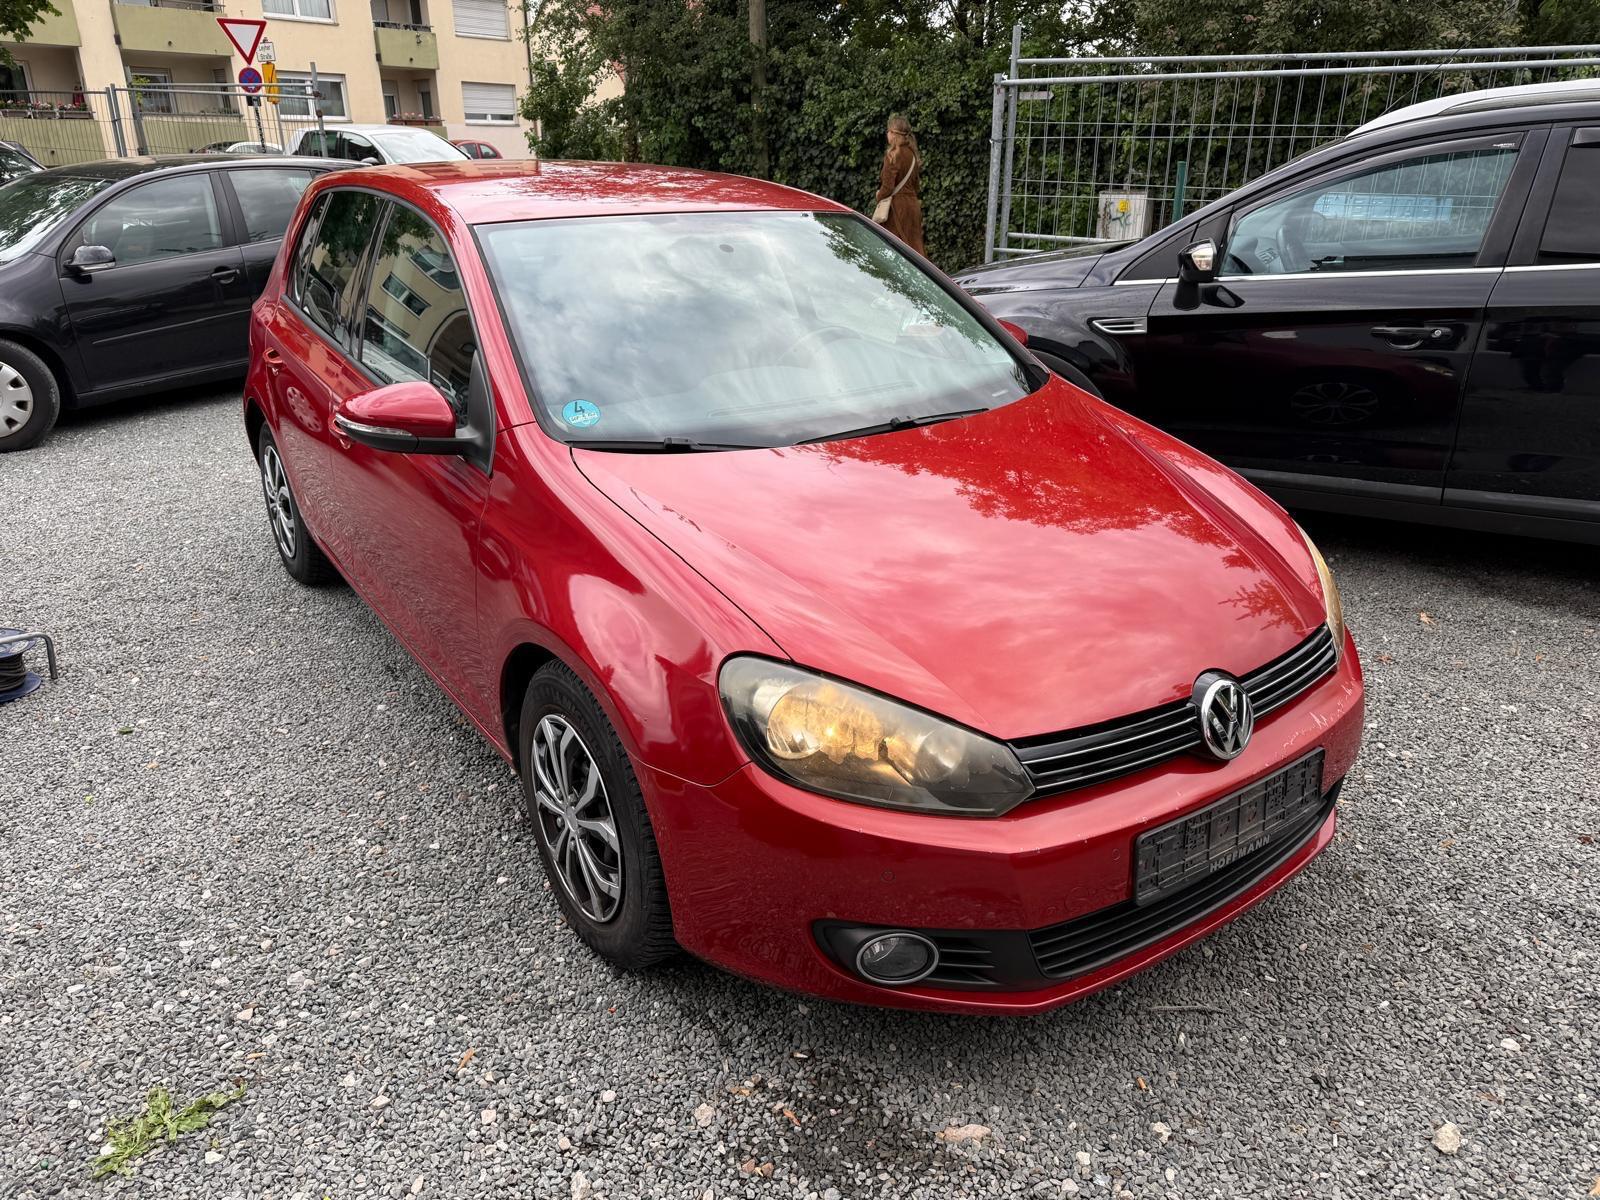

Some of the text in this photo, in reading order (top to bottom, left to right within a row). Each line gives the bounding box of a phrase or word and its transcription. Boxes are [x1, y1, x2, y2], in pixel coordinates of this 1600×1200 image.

[574, 401, 585, 413] 4
[1204, 682, 1252, 758] VW
[1209, 834, 1271, 873] HOFFMANN
